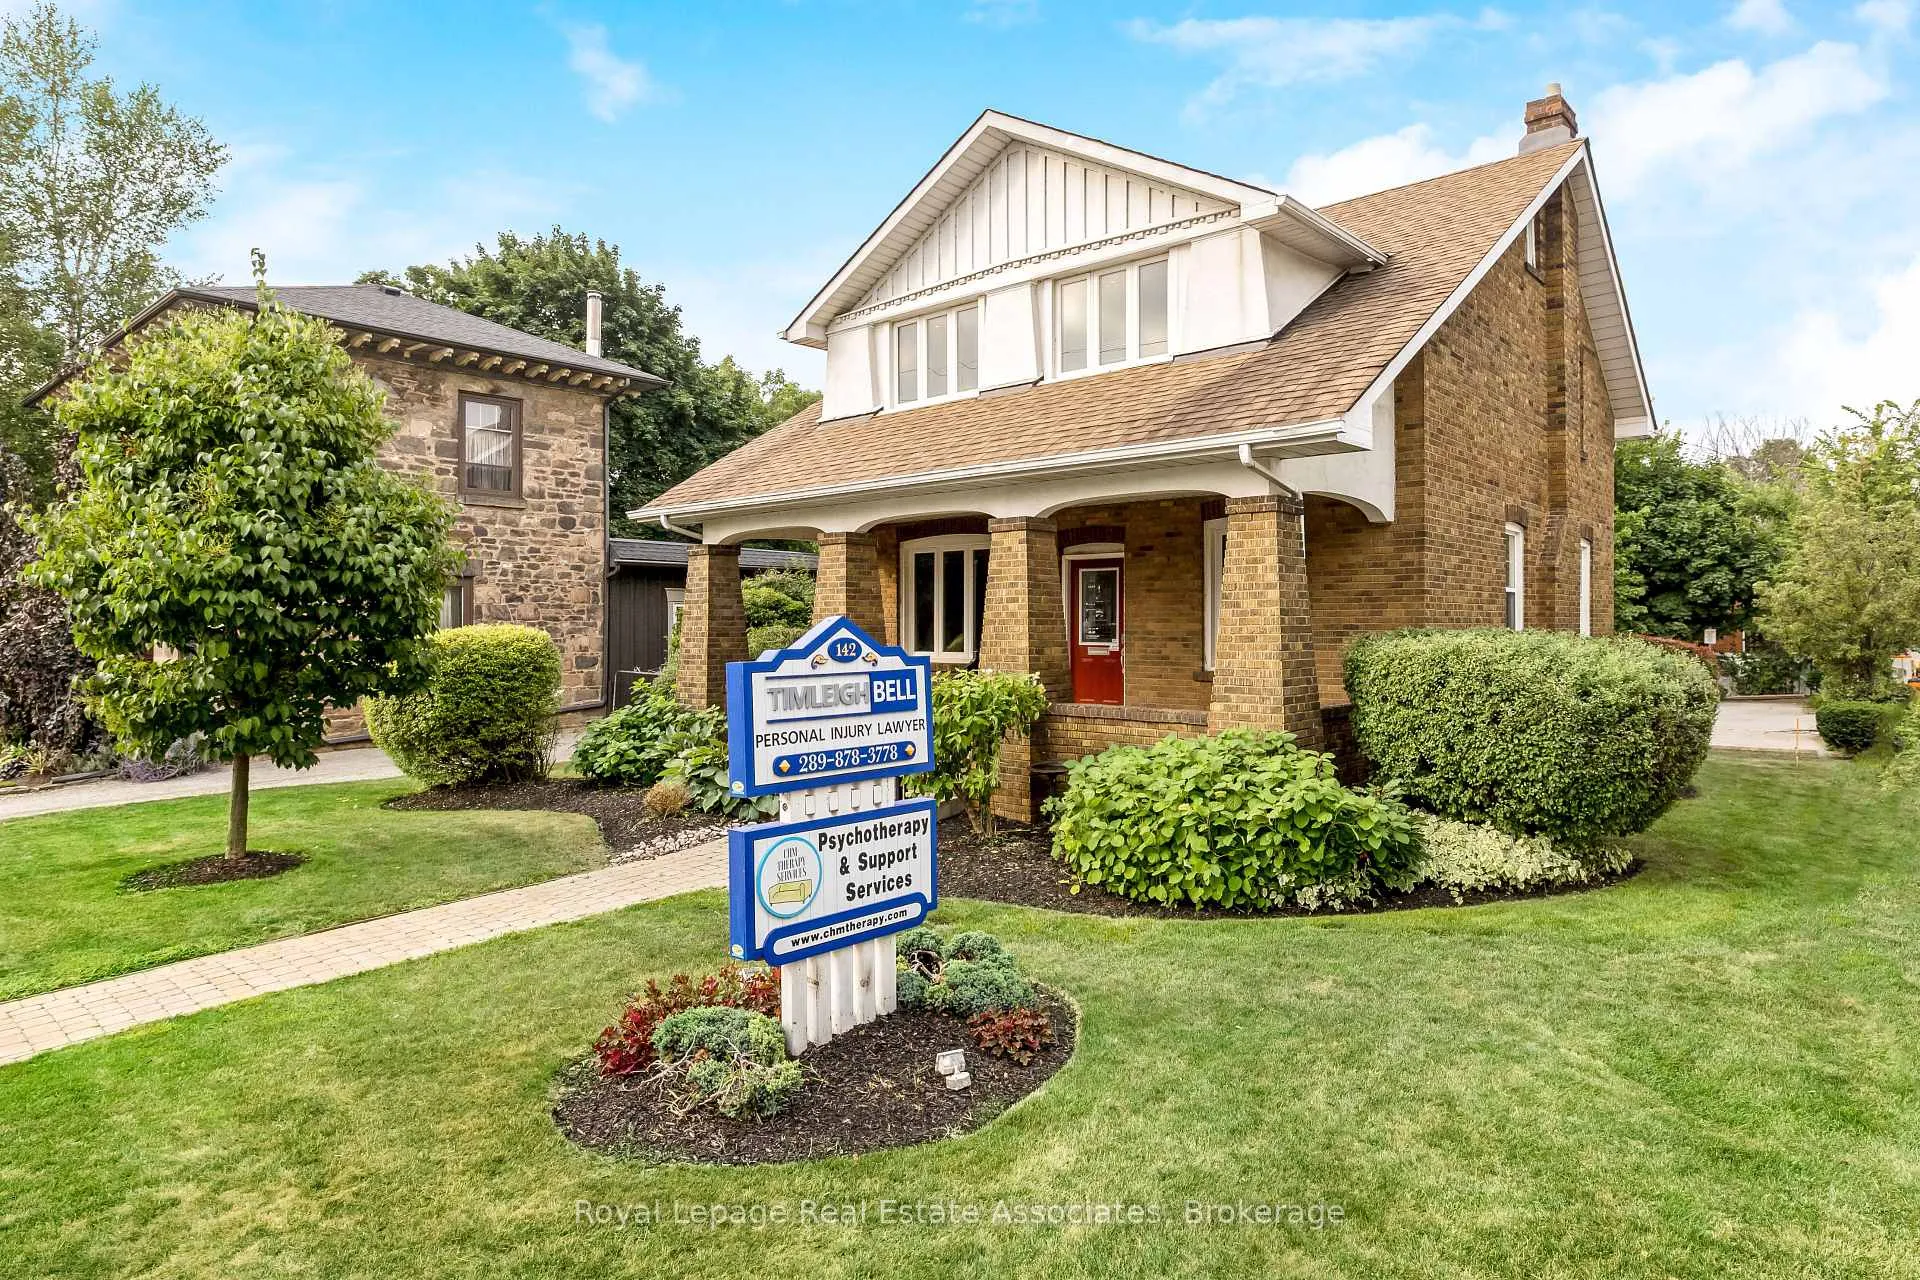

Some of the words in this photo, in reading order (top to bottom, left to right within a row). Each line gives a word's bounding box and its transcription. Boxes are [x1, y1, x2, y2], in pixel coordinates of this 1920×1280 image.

[835, 642, 856, 657] 142
[873, 678, 916, 703] BELL
[755, 728, 826, 748] PERSONAL
[830, 723, 872, 740] INJURY
[877, 718, 926, 735] LAWYER
[799, 744, 898, 773] 289-878-3778
[818, 816, 929, 853] Psychotherapy
[839, 856, 850, 875] &
[858, 842, 918, 871] Support
[846, 873, 912, 902] Services
[791, 909, 908, 947] www.chmtherapy.com
